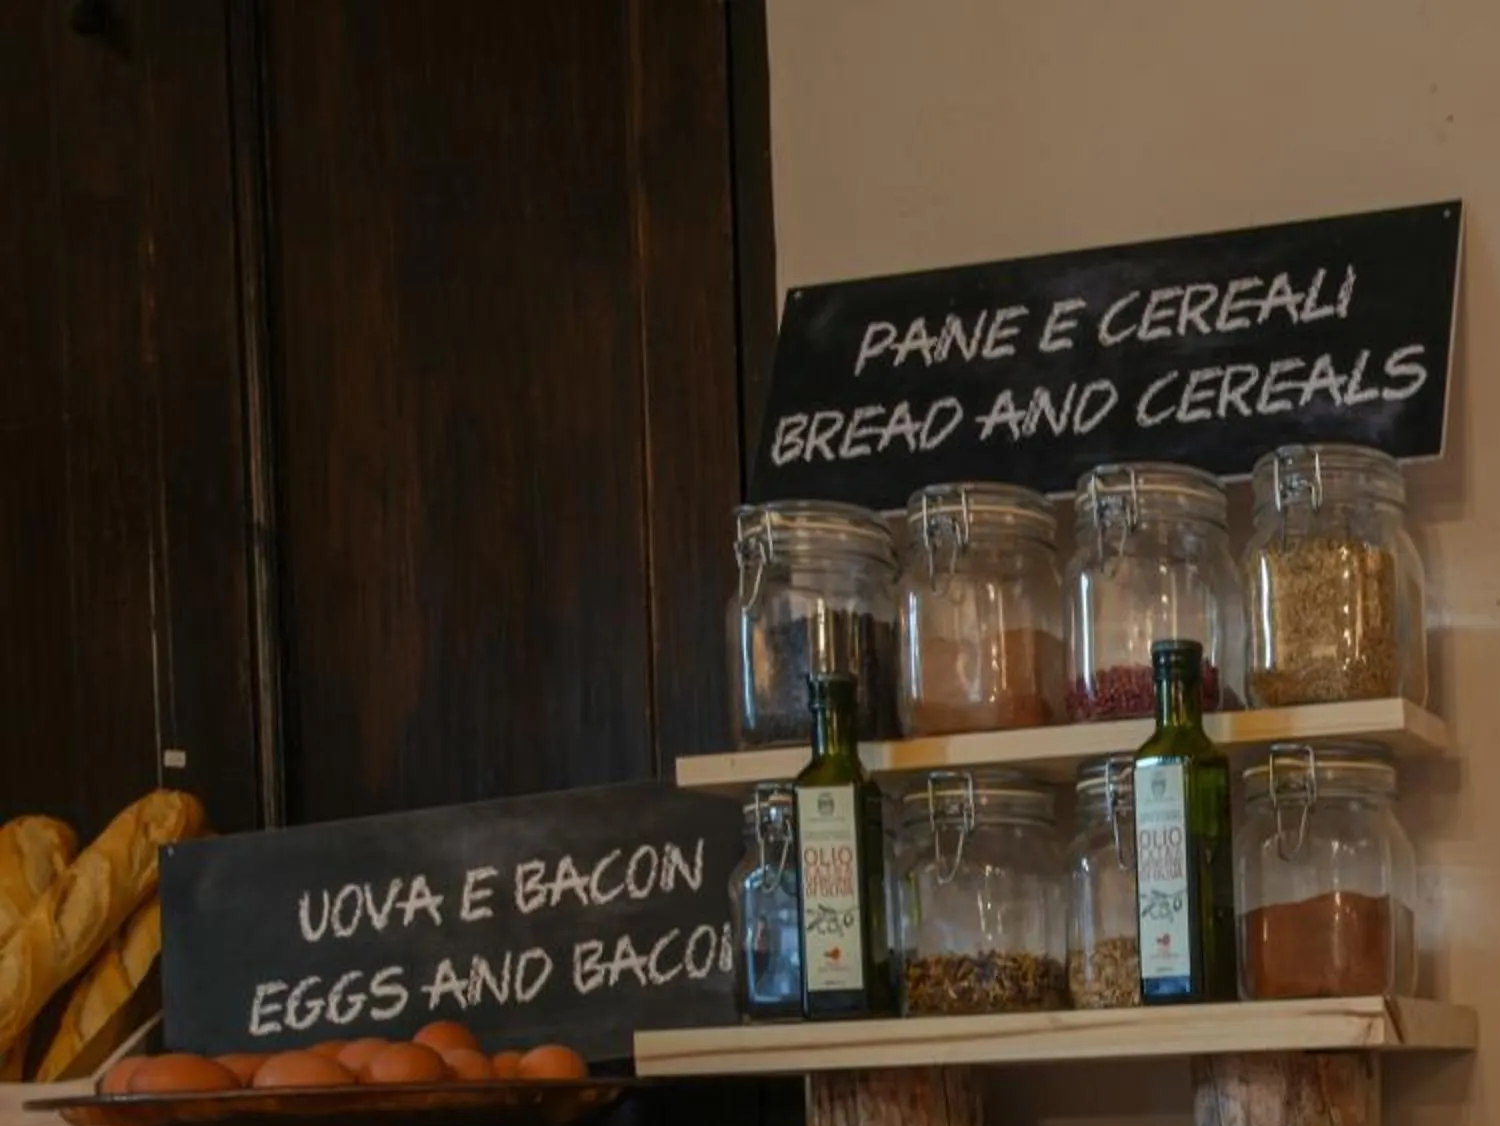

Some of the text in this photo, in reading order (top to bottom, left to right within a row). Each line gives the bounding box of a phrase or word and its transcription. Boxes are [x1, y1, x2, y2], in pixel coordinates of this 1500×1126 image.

[854, 265, 1355, 375] PANE E CEREALI
[771, 345, 1427, 467] BREAD AND CEREALS
[803, 846, 853, 867] OLIO
[1139, 825, 1182, 849] OLIO
[299, 839, 704, 942] UOVA E BACON
[250, 966, 409, 1036] EGGS
[422, 947, 553, 1010] AND
